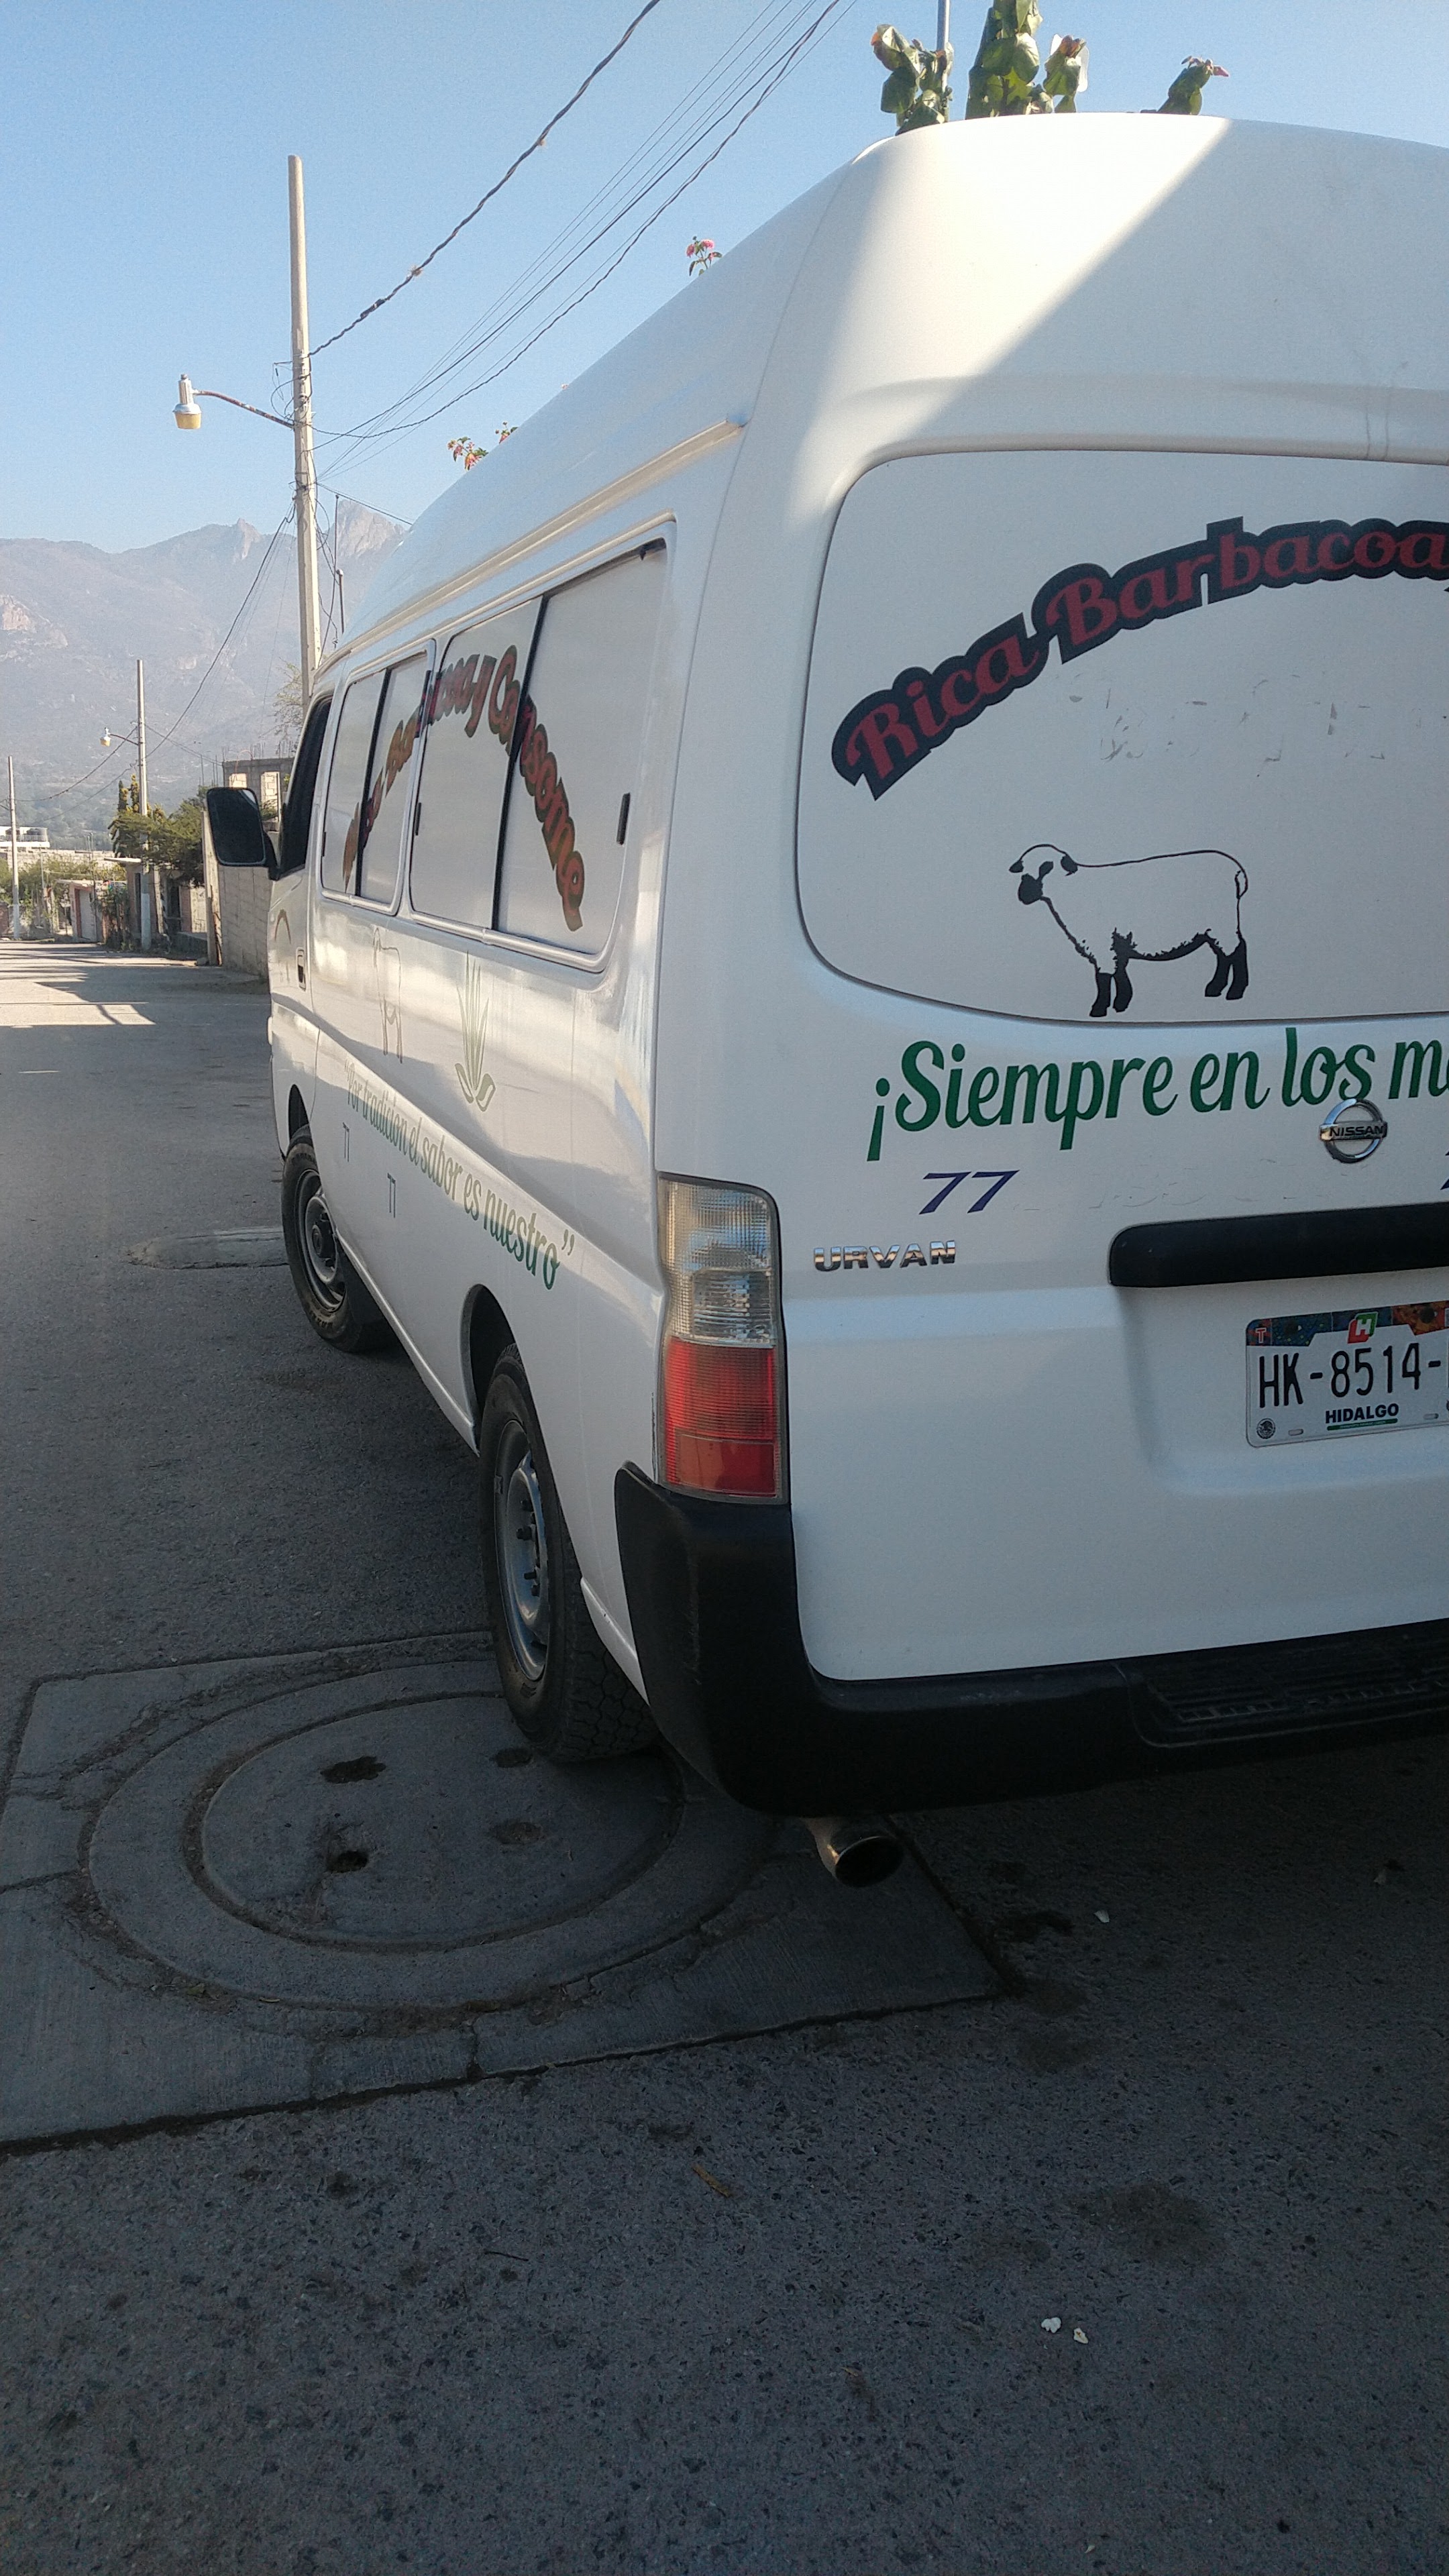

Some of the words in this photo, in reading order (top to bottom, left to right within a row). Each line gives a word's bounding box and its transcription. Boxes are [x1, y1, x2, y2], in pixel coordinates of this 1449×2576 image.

[840, 621, 1045, 788] Rica
[1038, 524, 1449, 653] Barbacoa
[867, 1040, 1179, 1161] ¡Siempre
[1190, 1051, 1271, 1112] en
[1281, 1028, 1375, 1105] los
[1389, 1040, 1449, 1099] m
[1329, 1124, 1385, 1138] NISSAN
[409, 1117, 422, 1165] el
[421, 1134, 463, 1201] sabor
[464, 1173, 482, 1220] es
[918, 1170, 1020, 1215] 77
[814, 1240, 956, 1272] URVAN
[1255, 1327, 1267, 1344] T
[1258, 1342, 1449, 1408] HK-8514-
[1325, 1403, 1399, 1424] HIDALGO
